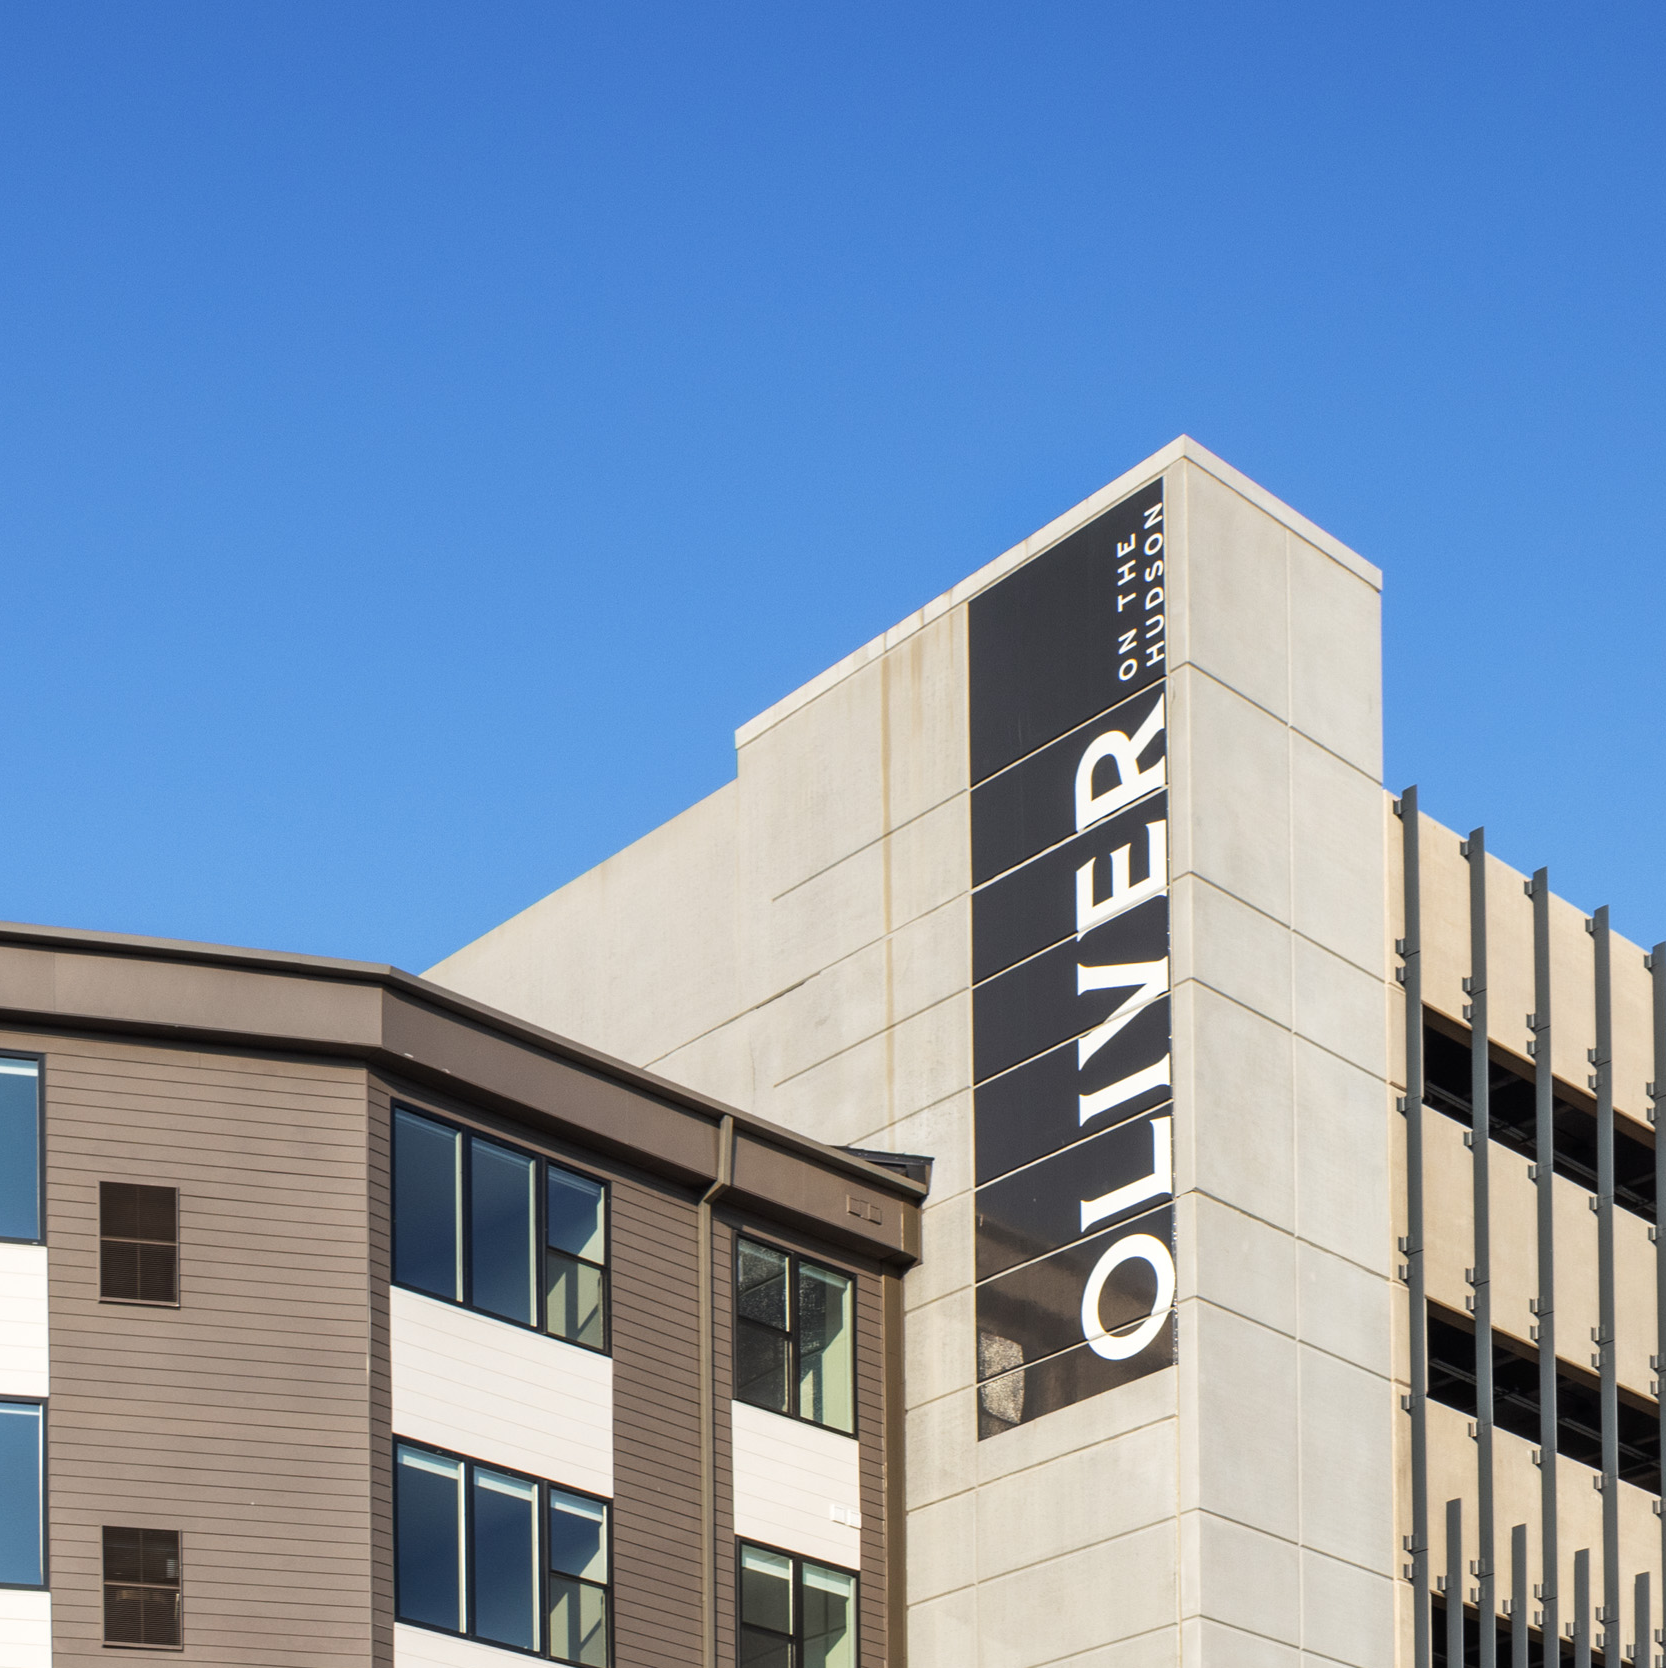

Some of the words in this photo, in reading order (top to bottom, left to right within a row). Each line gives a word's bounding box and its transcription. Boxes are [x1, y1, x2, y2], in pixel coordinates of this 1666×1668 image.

[1116, 532, 1137, 613] THE
[1143, 501, 1166, 668] HUDSON
[1118, 627, 1138, 682] ON
[1075, 692, 1176, 1361] OLIVER
